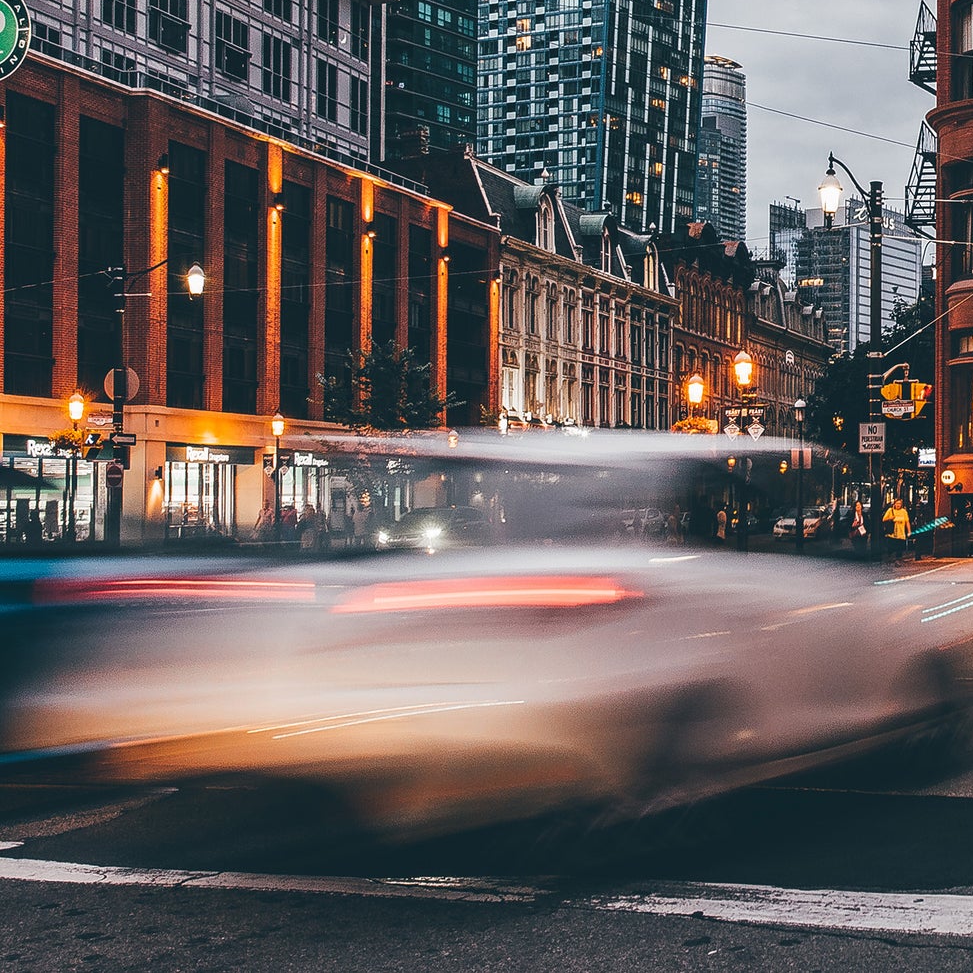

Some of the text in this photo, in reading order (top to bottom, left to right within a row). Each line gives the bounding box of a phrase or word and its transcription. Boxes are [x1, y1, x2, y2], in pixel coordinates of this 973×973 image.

[867, 425, 878, 435] NO
[186, 446, 209, 461] Rexall
[294, 452, 313, 466] Rexall
